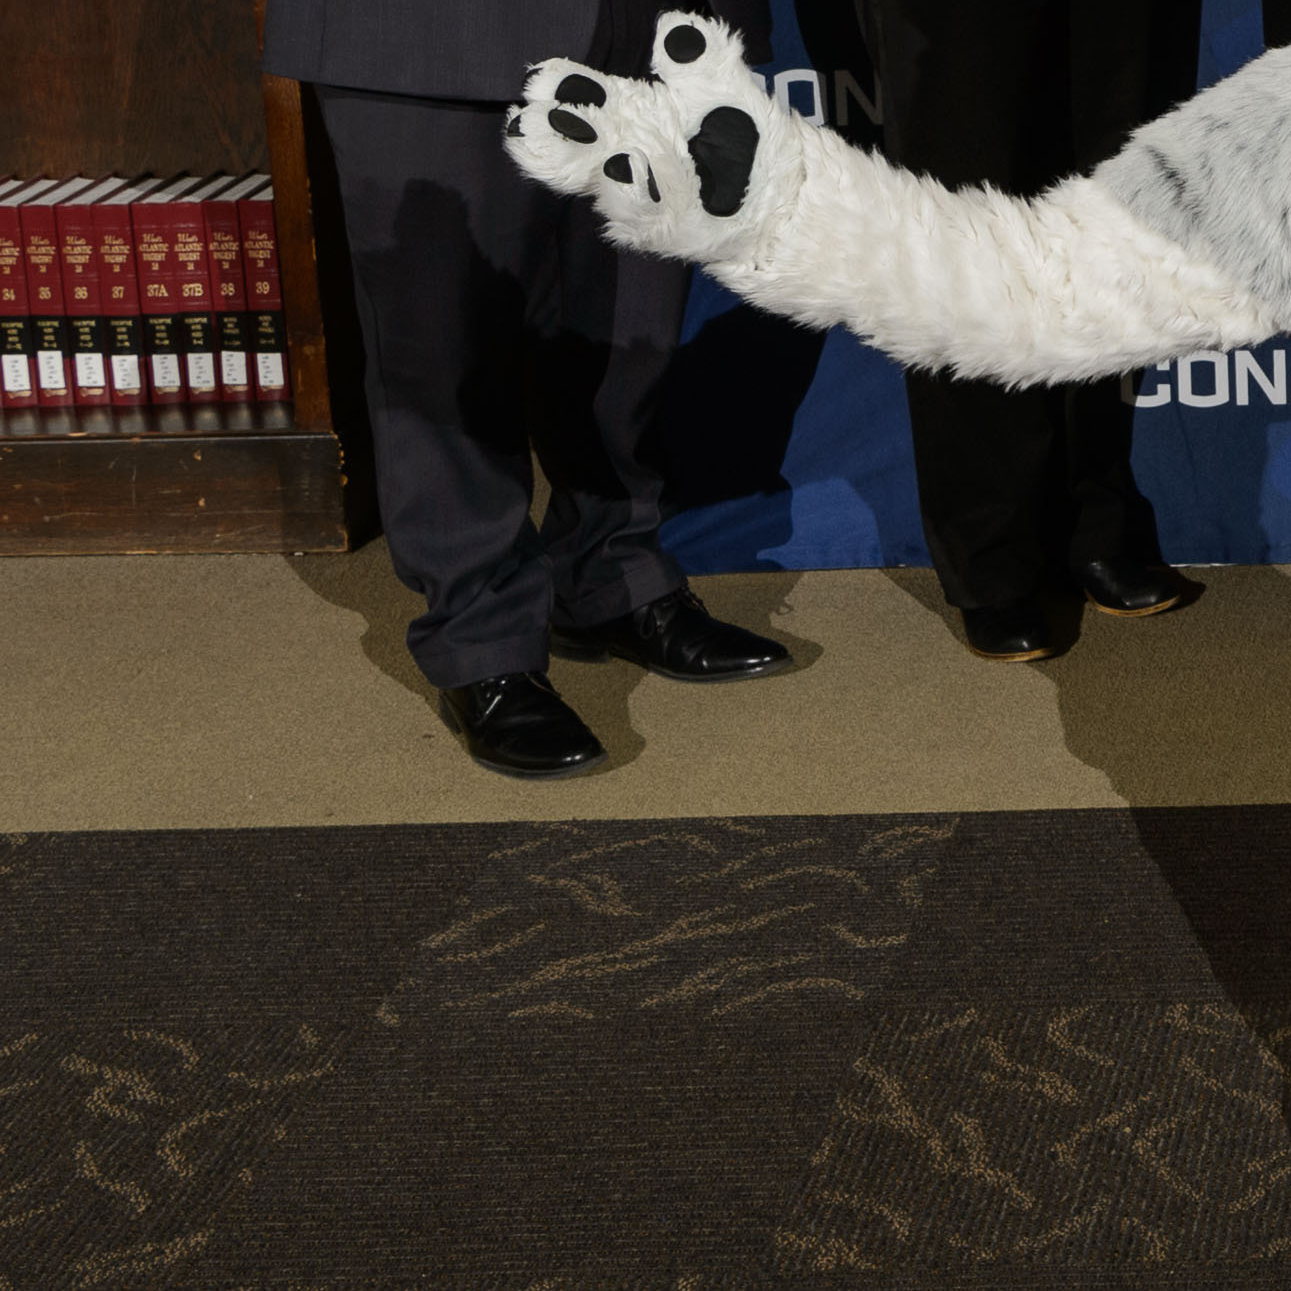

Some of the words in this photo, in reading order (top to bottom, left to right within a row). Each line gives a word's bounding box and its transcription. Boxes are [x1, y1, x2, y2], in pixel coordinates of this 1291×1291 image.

[112, 286, 125, 298] 37
[147, 284, 168, 297] 37A
[182, 284, 203, 297] 37B
[221, 283, 235, 296] 38
[256, 282, 269, 295] 39
